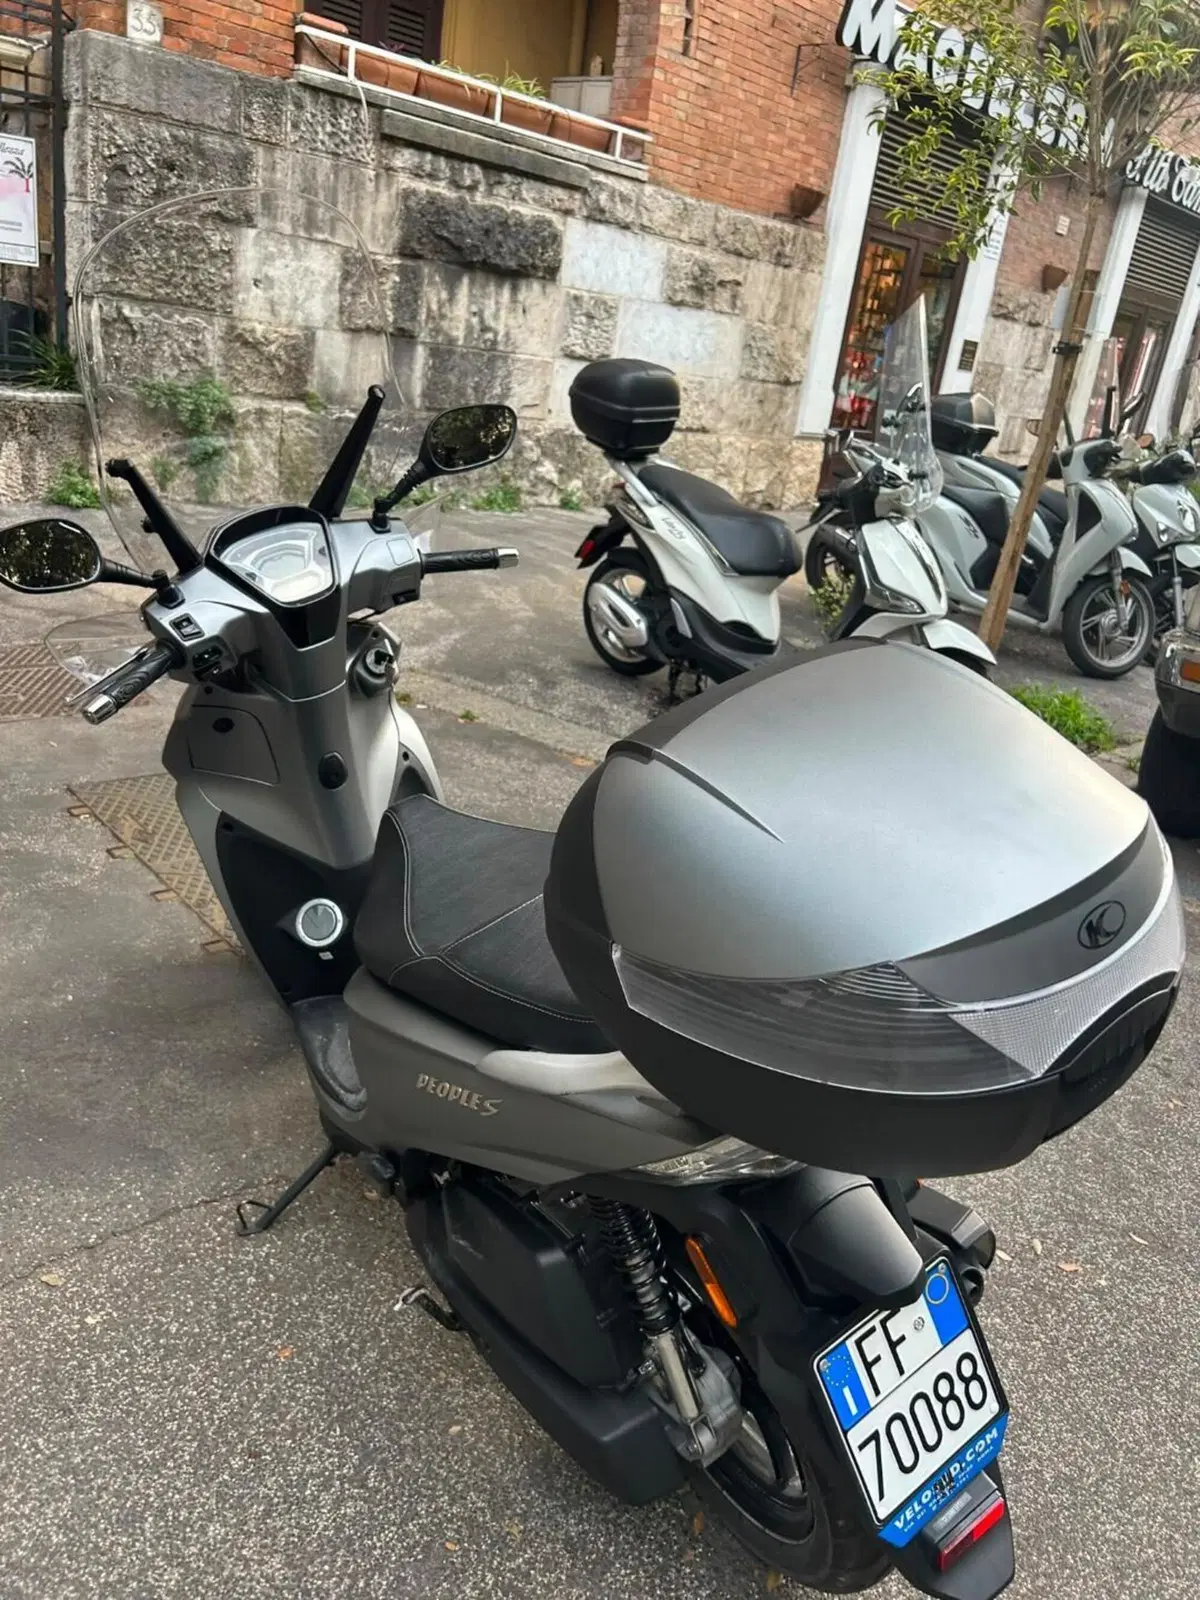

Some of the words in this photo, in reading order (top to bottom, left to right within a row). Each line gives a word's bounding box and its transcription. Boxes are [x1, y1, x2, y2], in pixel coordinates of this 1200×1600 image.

[416, 1072, 484, 1110] PEOPLE
[480, 1099, 504, 1116] S
[854, 1309, 906, 1398] FF
[857, 1352, 988, 1502] 70088
[894, 1427, 998, 1530] VELOD.COM
